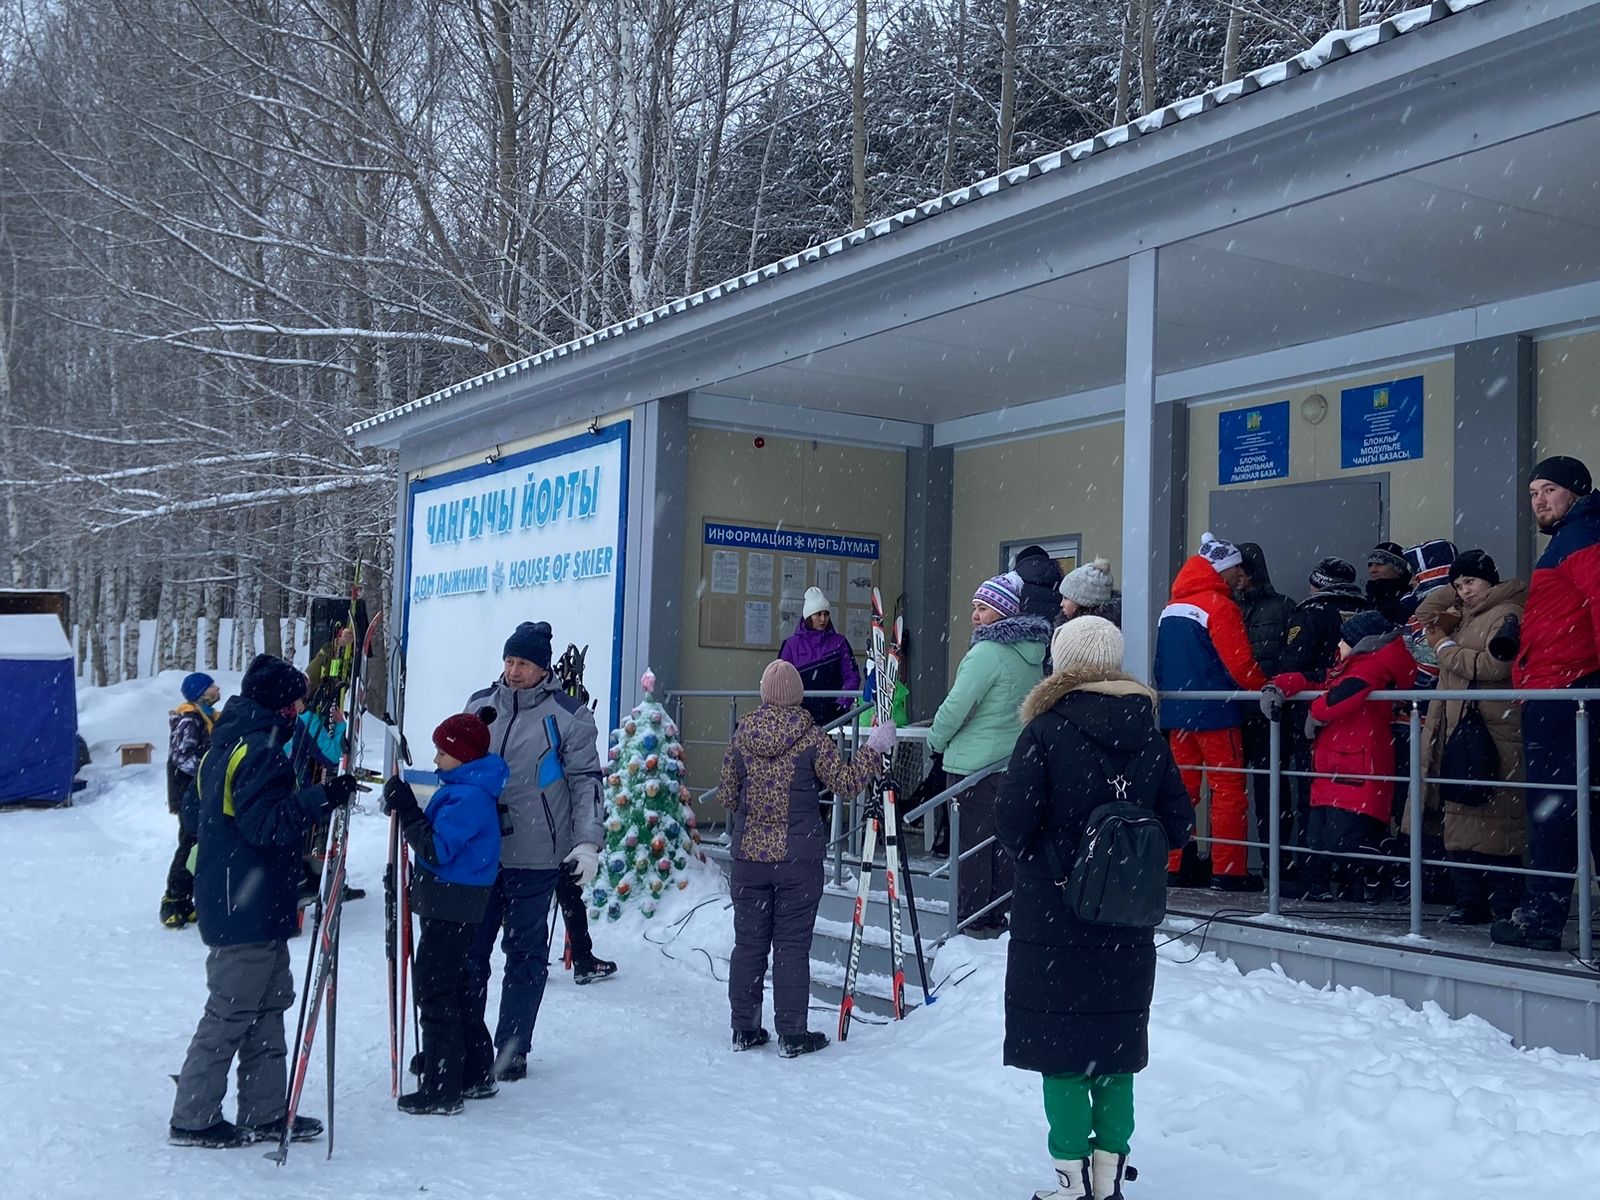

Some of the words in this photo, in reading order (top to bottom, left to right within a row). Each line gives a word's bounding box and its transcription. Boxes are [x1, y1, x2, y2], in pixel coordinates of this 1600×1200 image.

[1234, 461, 1274, 474] МОДУЛЬНАЯ
[1380, 450, 1409, 461] БАЗАСЫ
[1230, 471, 1260, 482] ЛЫЖНАЯ
[1260, 469, 1277, 478] БАЗА
[426, 486, 517, 545] ЧАҢГЫЧЫ
[520, 465, 600, 529] ЙОРТЫ
[708, 527, 793, 547] ИНФОРМАЦИЯ
[807, 536, 876, 554] МӘГЪЛҮМАТ
[413, 573, 435, 601] ДОМ
[436, 565, 488, 595] ЛЫЖНИКА
[508, 554, 550, 587] HOUSE
[552, 552, 571, 581] OF
[572, 546, 614, 579] SKIER
[890, 901, 904, 967] SPORT
[847, 926, 863, 992] SPORT
[310, 952, 324, 1013] SPORT
